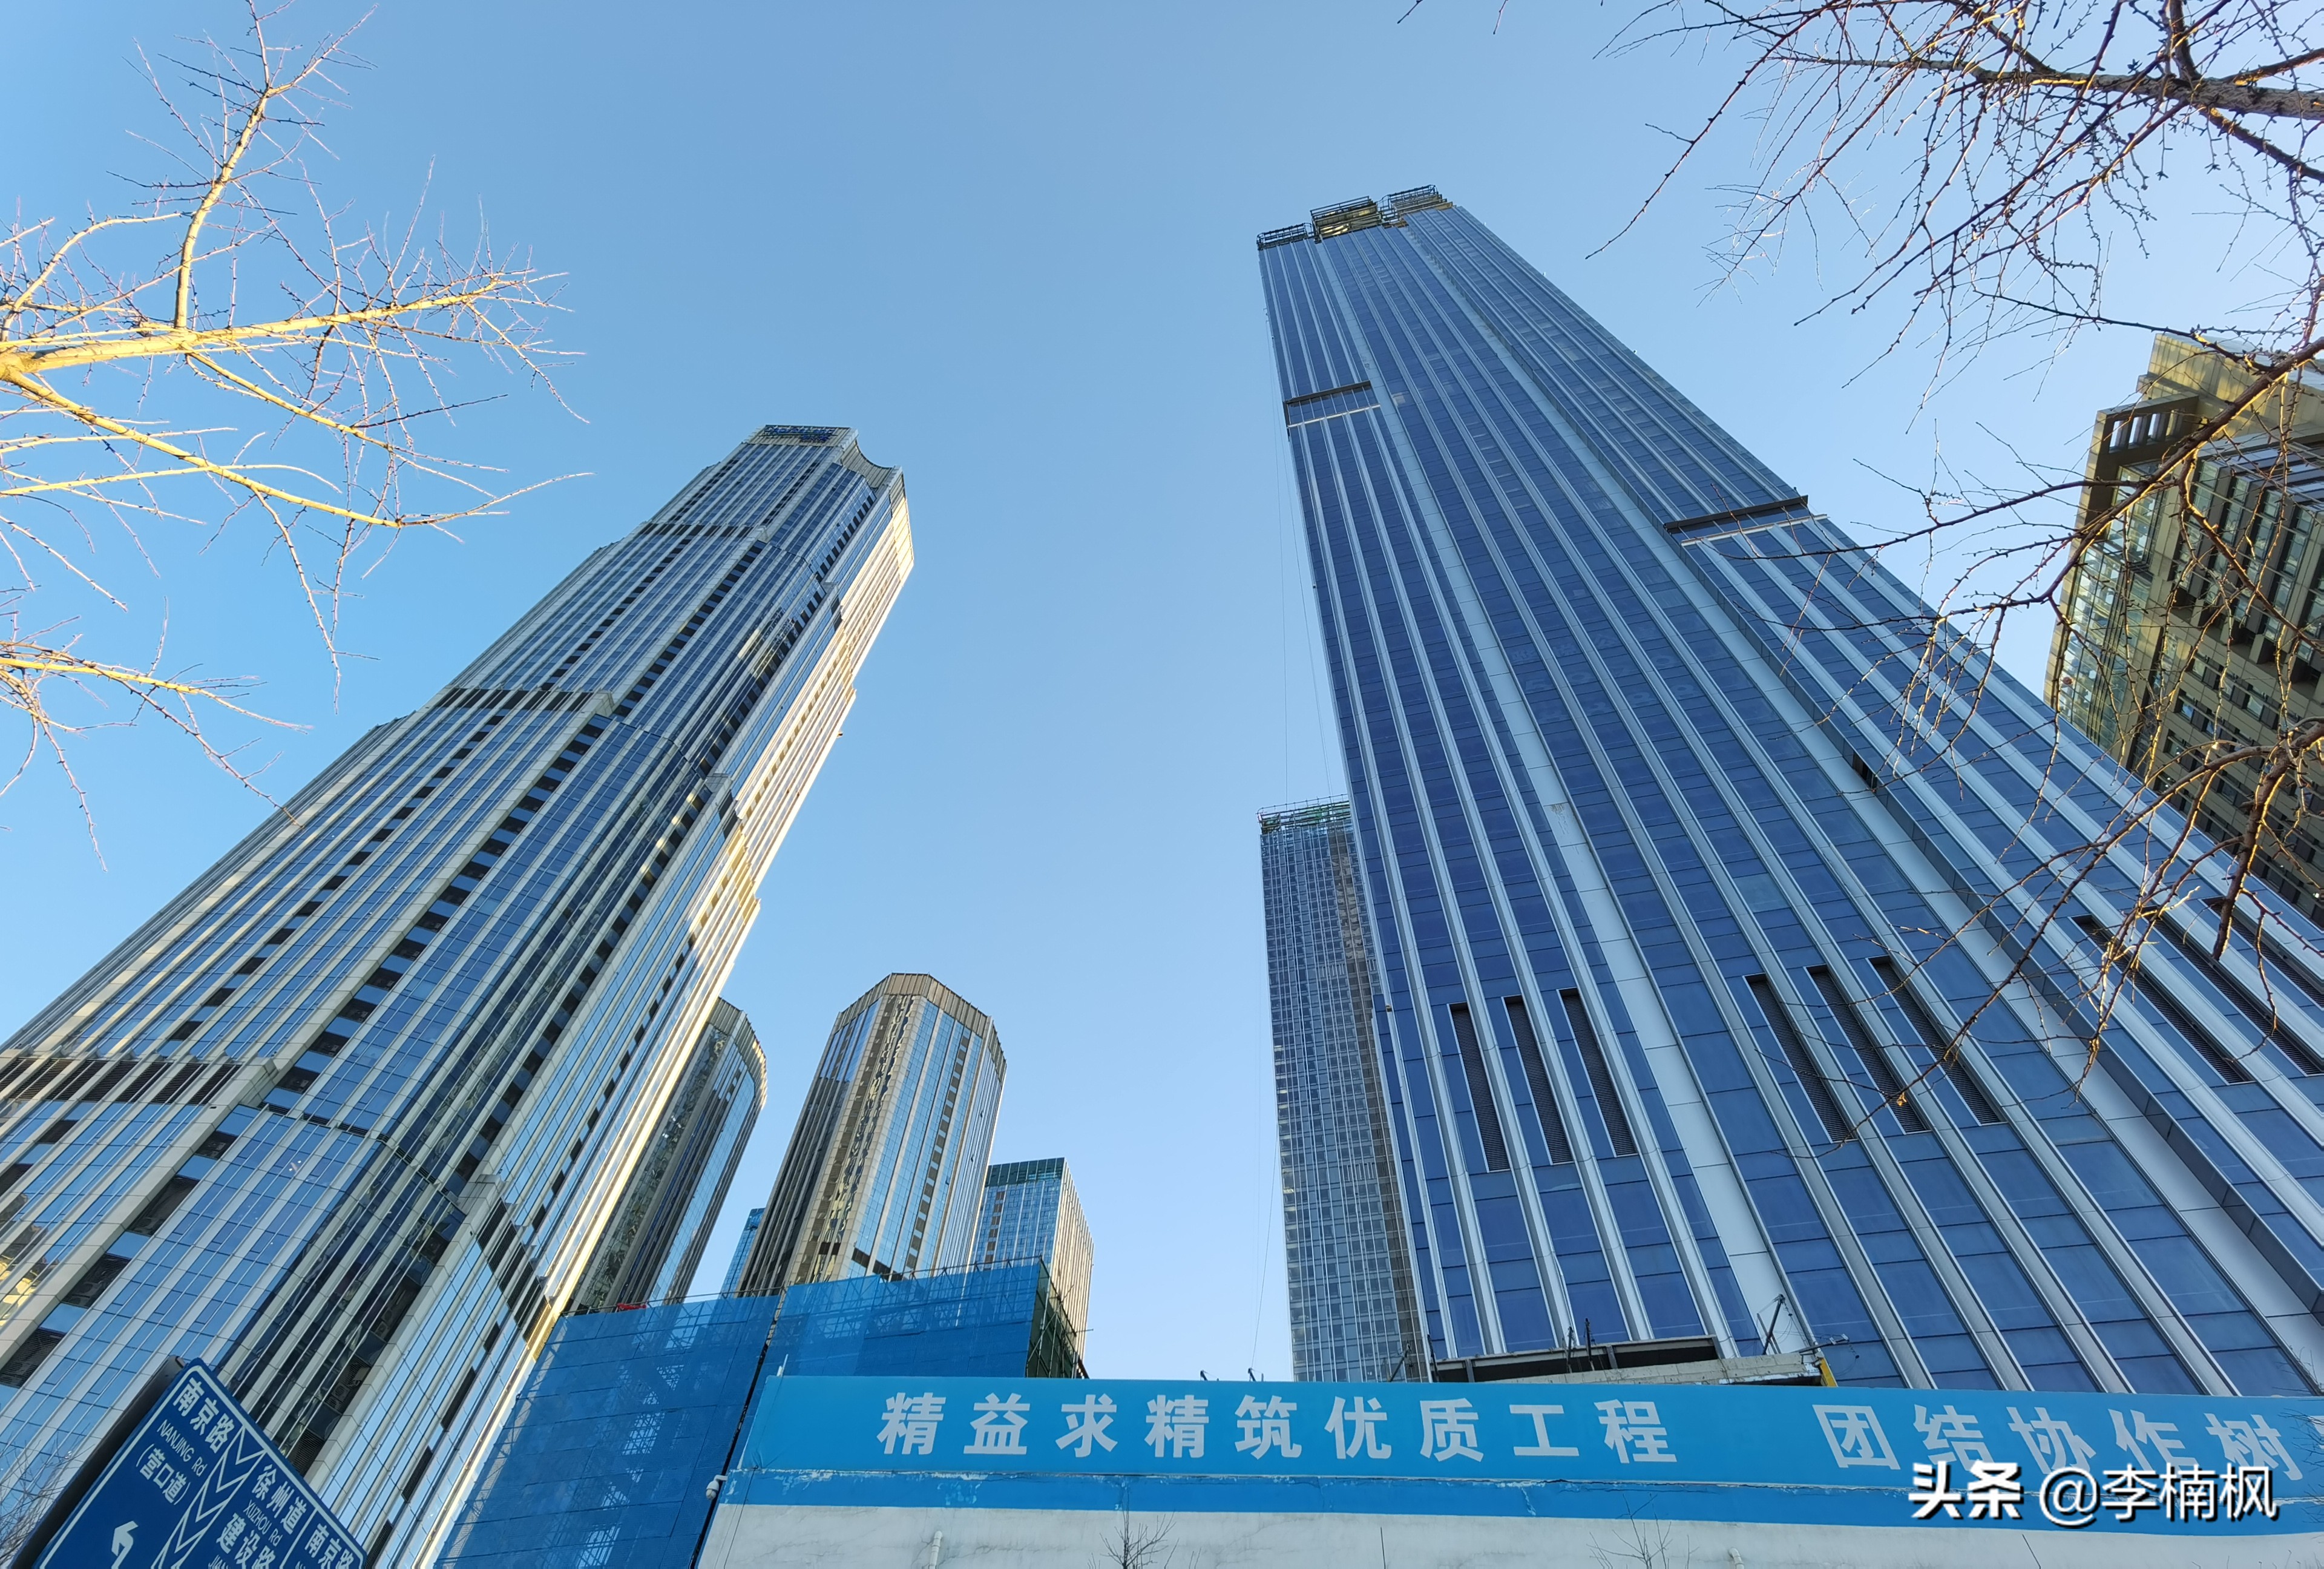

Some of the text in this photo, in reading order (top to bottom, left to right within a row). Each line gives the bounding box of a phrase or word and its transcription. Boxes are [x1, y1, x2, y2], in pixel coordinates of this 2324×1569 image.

[156, 1419, 208, 1477] NANJING Rd
[172, 1377, 235, 1453] 南京路
[877, 1392, 1677, 1463] 精益求精筑优质工程
[136, 1443, 191, 1505] (营口道)
[252, 1464, 306, 1534] 徐州道
[243, 1499, 283, 1547] XUZHOU Rd
